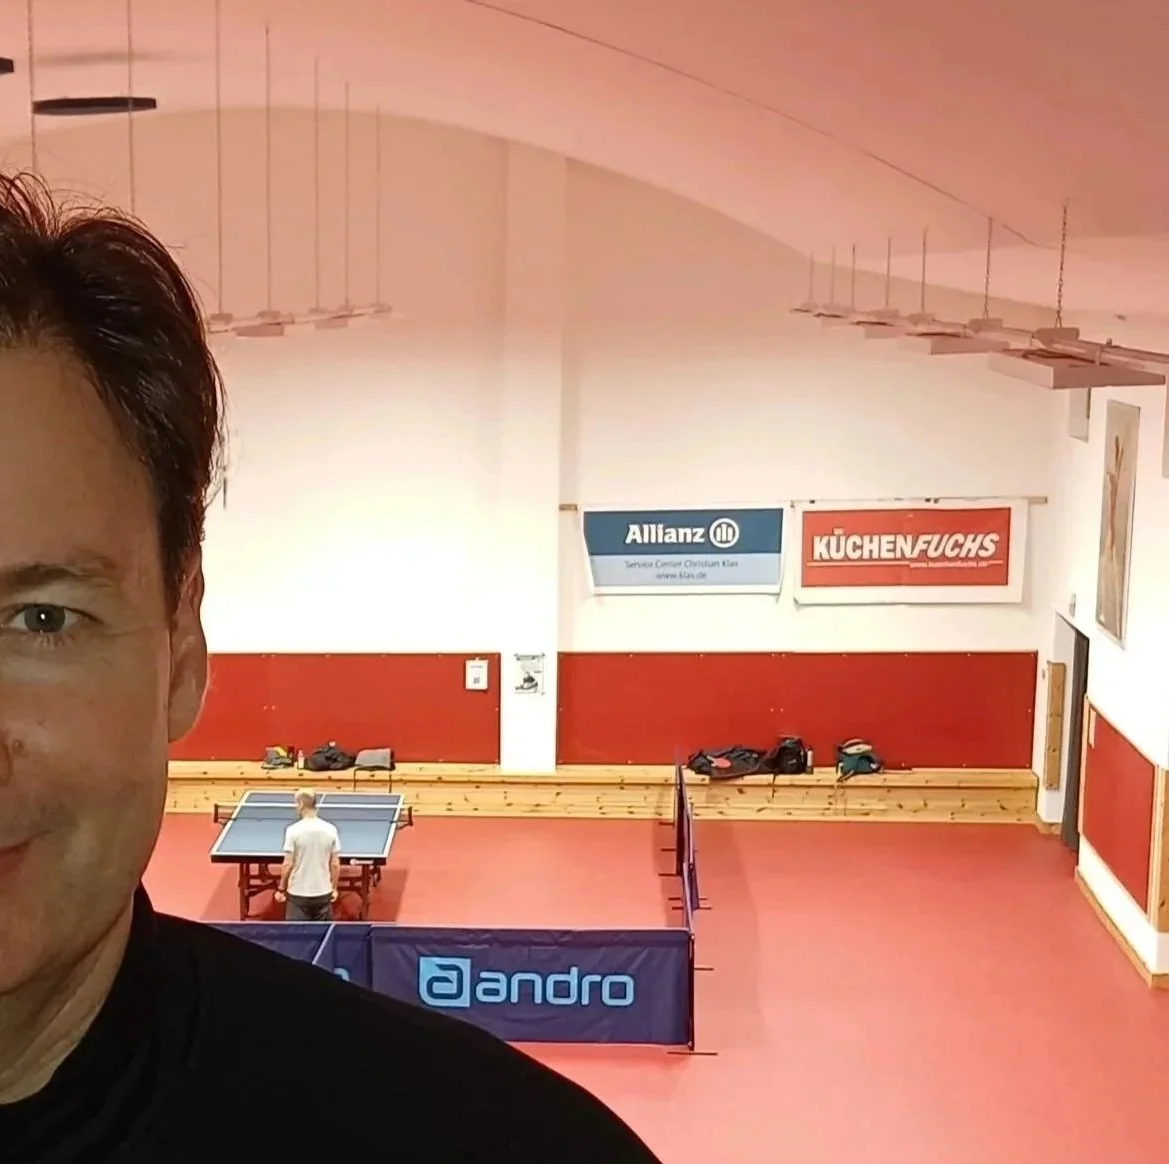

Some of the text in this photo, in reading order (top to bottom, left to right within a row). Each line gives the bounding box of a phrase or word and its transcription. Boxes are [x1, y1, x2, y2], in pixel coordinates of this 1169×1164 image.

[625, 523, 706, 544] Allianz
[813, 528, 1000, 560] KÜCHENFUCHS
[475, 966, 635, 1007] andro
